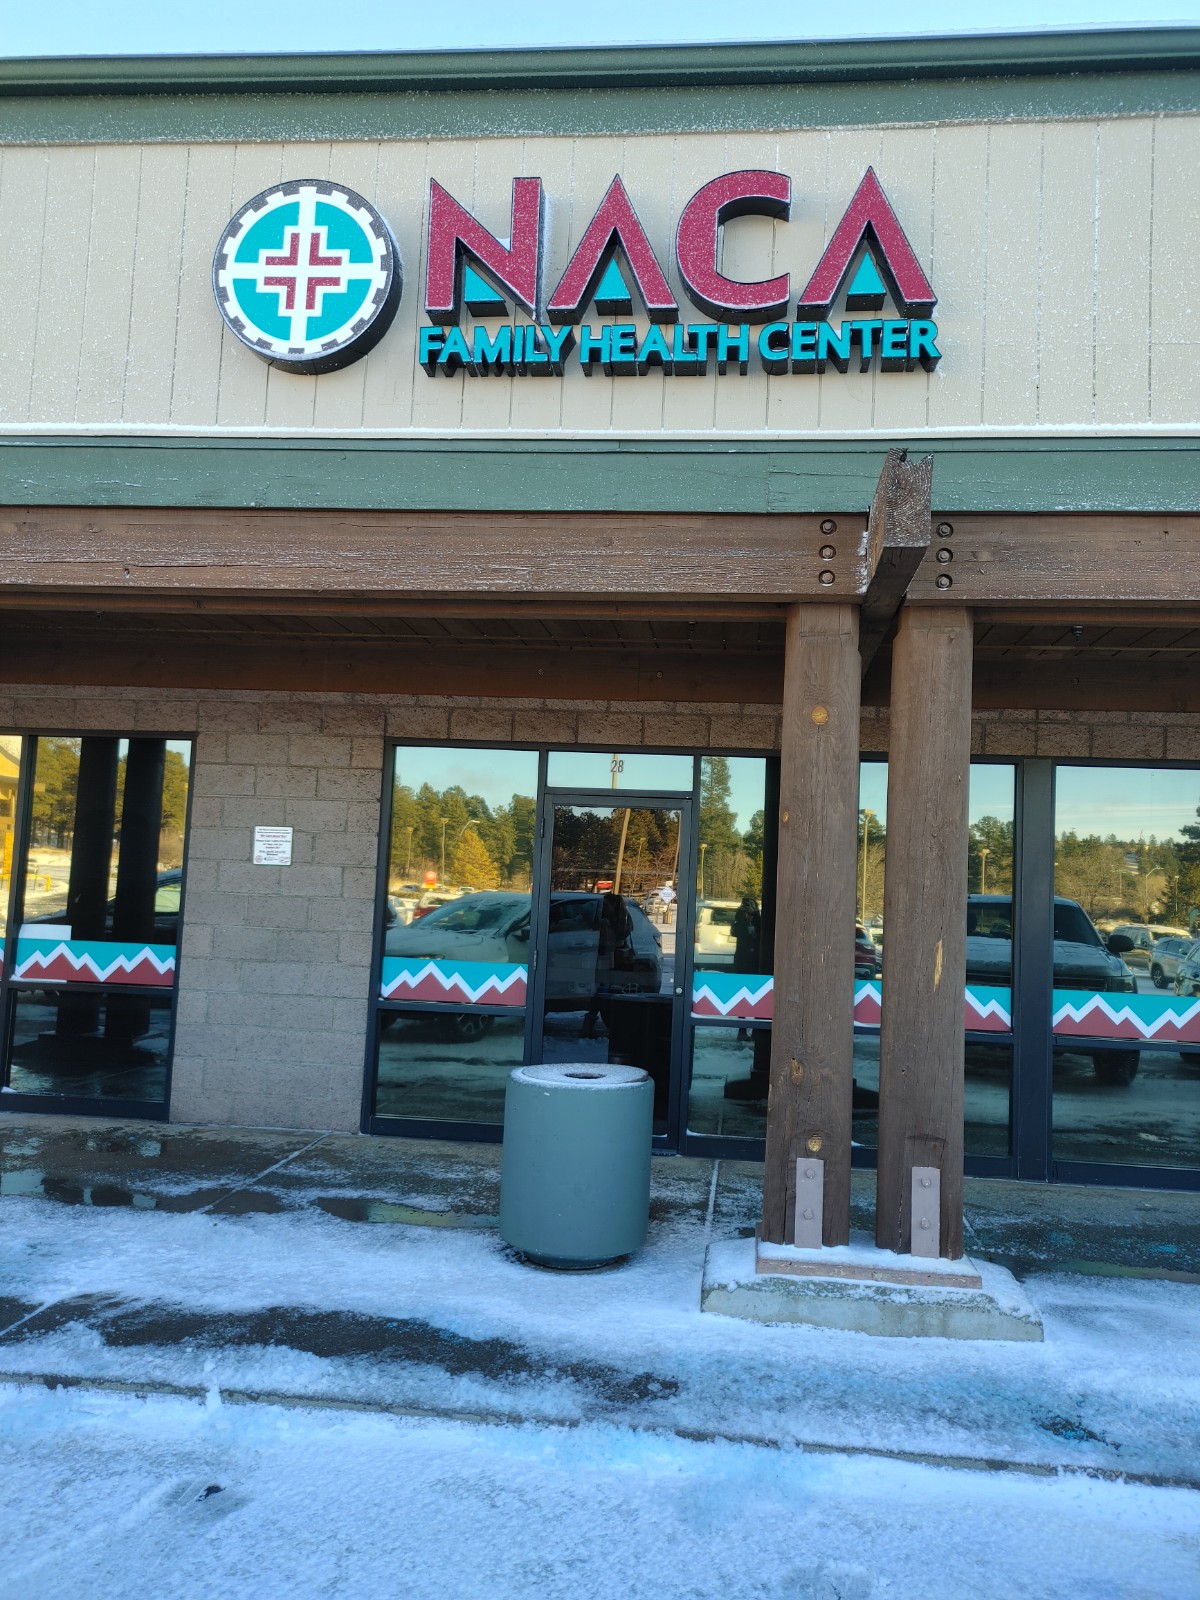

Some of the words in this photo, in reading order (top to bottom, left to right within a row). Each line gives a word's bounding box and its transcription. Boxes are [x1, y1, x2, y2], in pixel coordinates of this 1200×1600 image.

[425, 165, 939, 318] NACA
[419, 324, 574, 367] FAMILY
[579, 322, 750, 366] HEALTH
[758, 318, 943, 365] CENTER
[610, 759, 624, 773] 28
